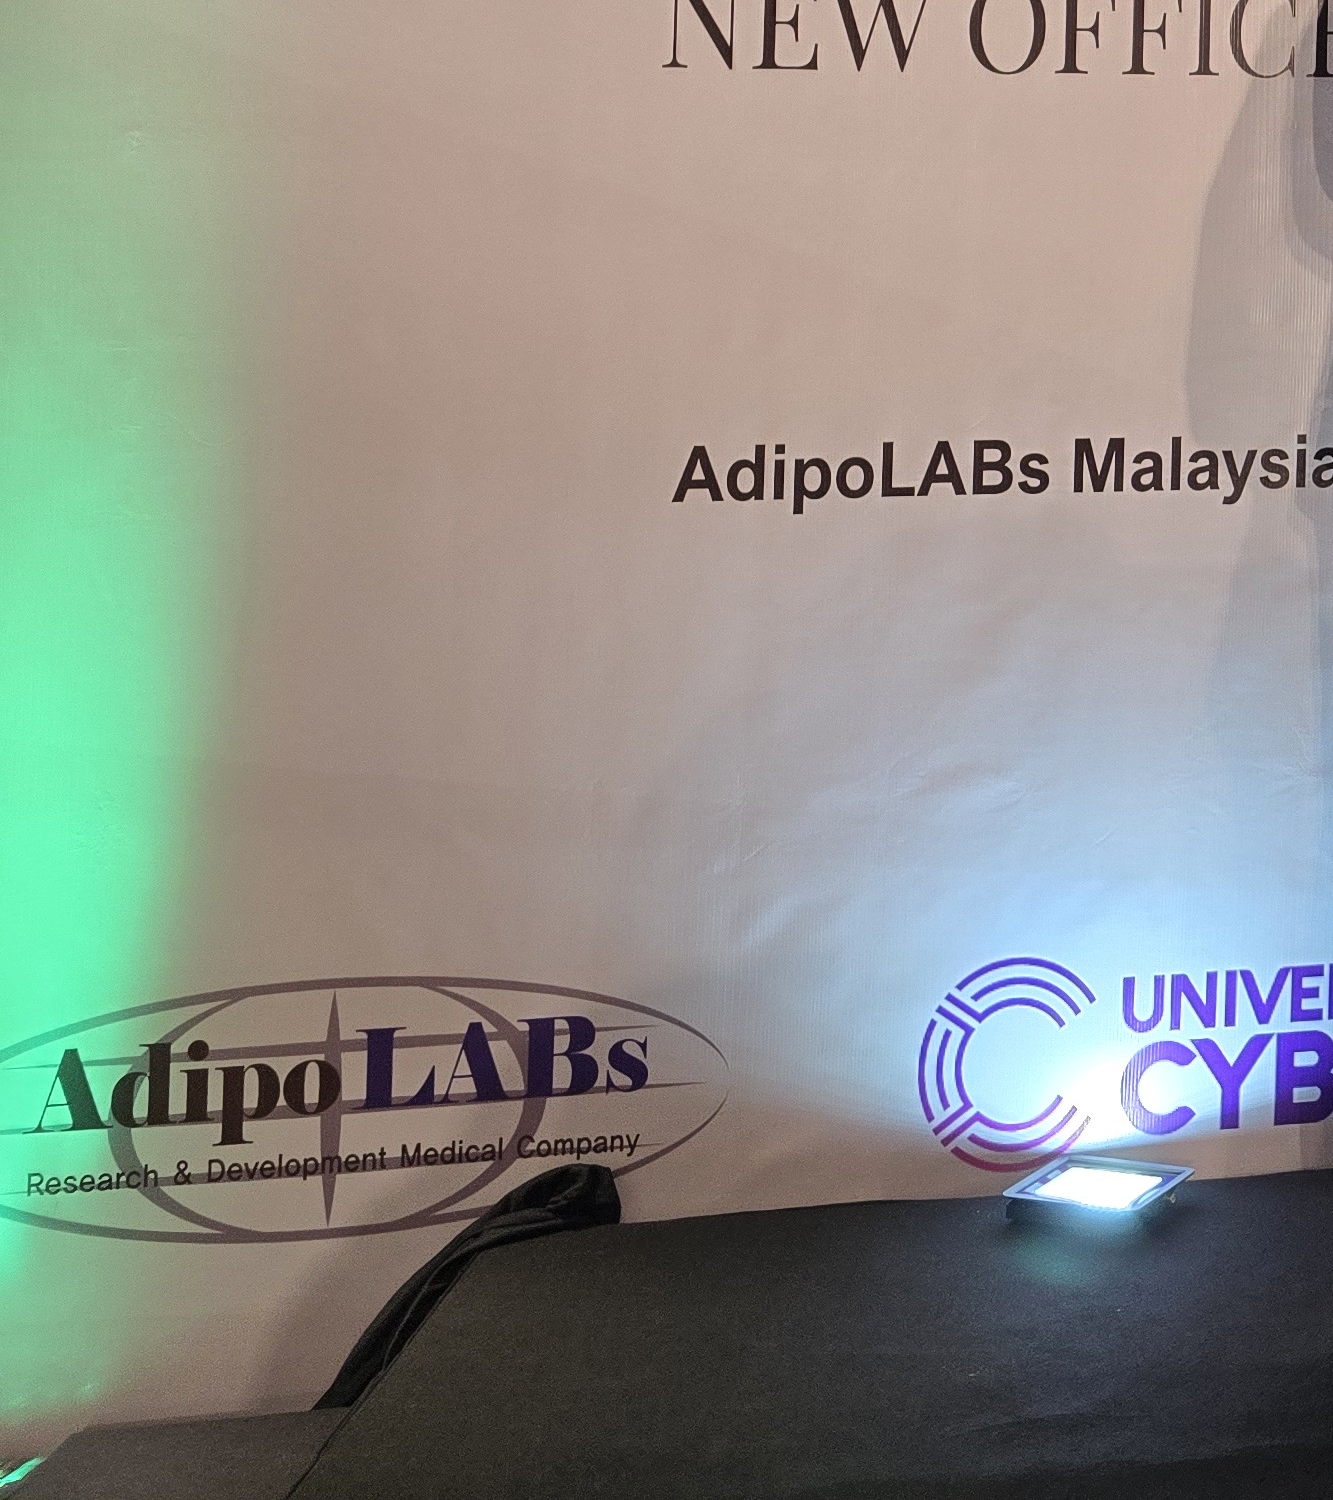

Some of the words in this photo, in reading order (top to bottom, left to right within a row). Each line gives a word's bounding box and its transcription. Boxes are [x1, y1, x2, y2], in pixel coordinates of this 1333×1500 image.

[671, 439, 1051, 515] AdipoLABs
[22, 1014, 650, 1148] AdipoLABs
[26, 1161, 160, 1198] Research
[173, 1160, 195, 1185] &
[206, 1144, 388, 1186] Development
[399, 1137, 505, 1170] Medical
[516, 1129, 641, 1161] Company
